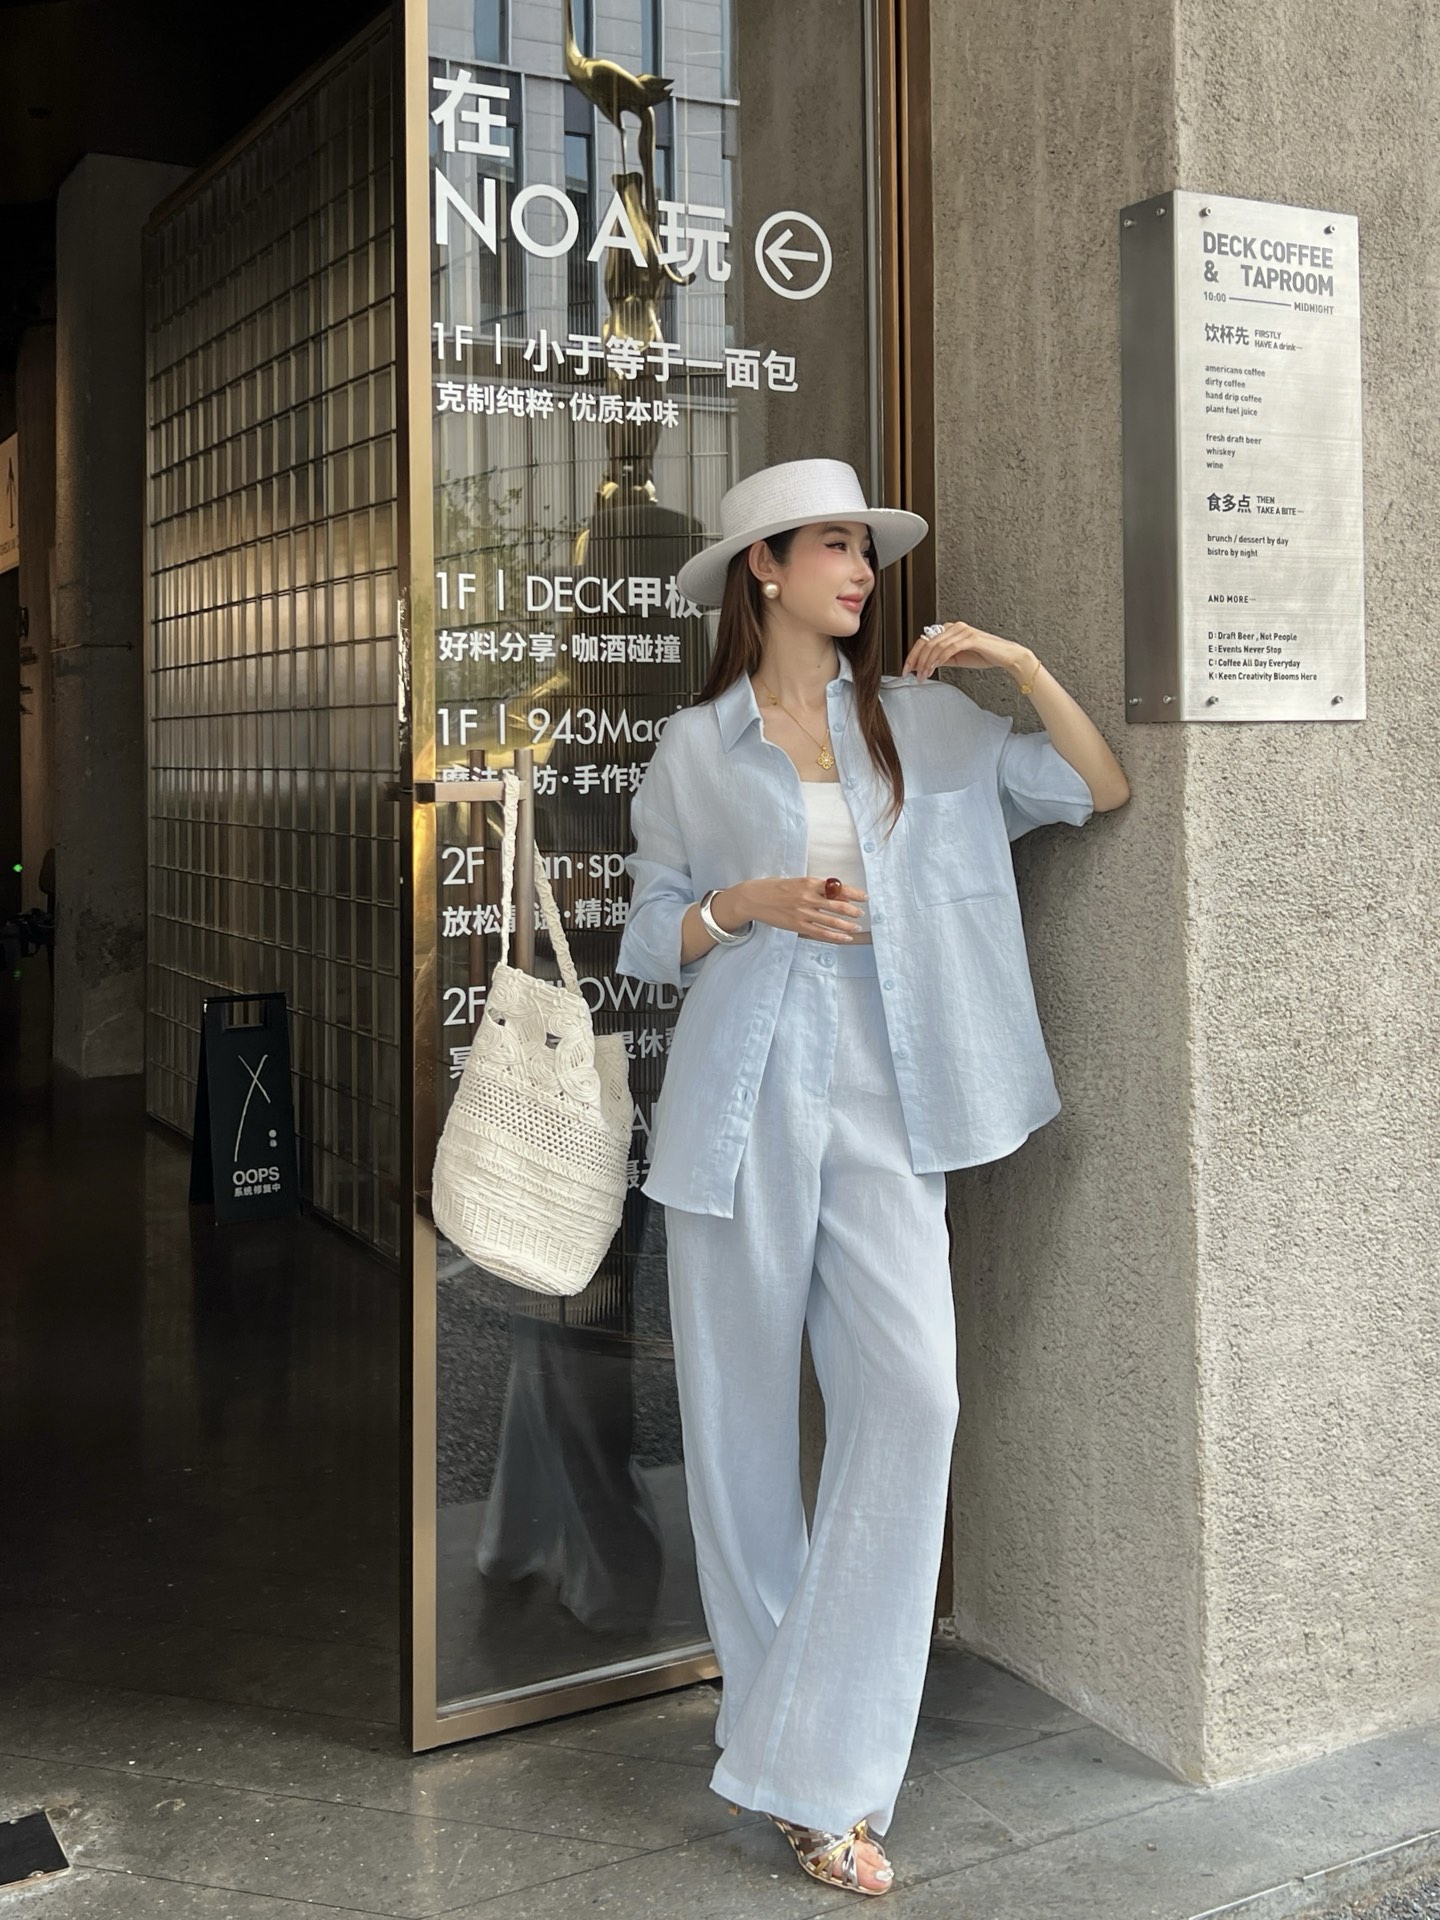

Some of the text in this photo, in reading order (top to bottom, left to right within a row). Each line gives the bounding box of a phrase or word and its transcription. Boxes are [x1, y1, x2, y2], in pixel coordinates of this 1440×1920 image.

[431, 69, 510, 158] 在
[435, 167, 731, 283] NOA玩
[1203, 231, 1334, 269] DECK COFFEE
[1204, 260, 1334, 297] & TAPROOM
[1204, 291, 1334, 315] 10:00 MIDNIGHT
[1204, 322, 1250, 346] 饮杯先
[1254, 329, 1281, 340] FIRSTLY
[1254, 340, 1272, 349] HAVE
[1273, 341, 1278, 350] A
[432, 322, 473, 361] 1F
[523, 328, 799, 392] 小于等于一面包
[1205, 365, 1266, 377] americano coffee
[1205, 377, 1246, 388] dirty coffee
[1205, 390, 1262, 403] hand drip coffee
[1205, 404, 1258, 416] plant fuel juice
[1206, 433, 1262, 445] fresh draft beer
[1206, 447, 1236, 458] whiskey
[1206, 461, 1224, 469] wine
[1207, 492, 1251, 513] 食多点
[1256, 495, 1275, 504] THEN
[1256, 506, 1274, 514] TAKE
[1275, 507, 1281, 515] A
[1207, 534, 1232, 543] brunch
[1239, 535, 1266, 544] dessert
[1267, 536, 1275, 546] by
[1276, 537, 1289, 547] day
[1207, 548, 1258, 558] bistro by night
[436, 571, 476, 610] 1F
[1208, 595, 1225, 603] AND
[1218, 631, 1236, 640] Draft
[1260, 632, 1272, 641] Not
[1273, 633, 1297, 642] People
[438, 630, 682, 664] 好料分享·咖酒碰撞
[1218, 645, 1242, 653] Events
[1243, 645, 1265, 653] Never
[1266, 646, 1282, 655] Stop
[1218, 659, 1241, 667] Coffee
[1242, 659, 1253, 667] All
[1254, 659, 1267, 668] Day
[1268, 659, 1300, 668] Everyday
[1218, 672, 1236, 680] Keen
[1238, 672, 1272, 681] Creativity
[437, 708, 478, 746] 1F
[442, 847, 484, 885] 2F
[443, 986, 486, 1026] 2F
[233, 1166, 280, 1186] OOPS
